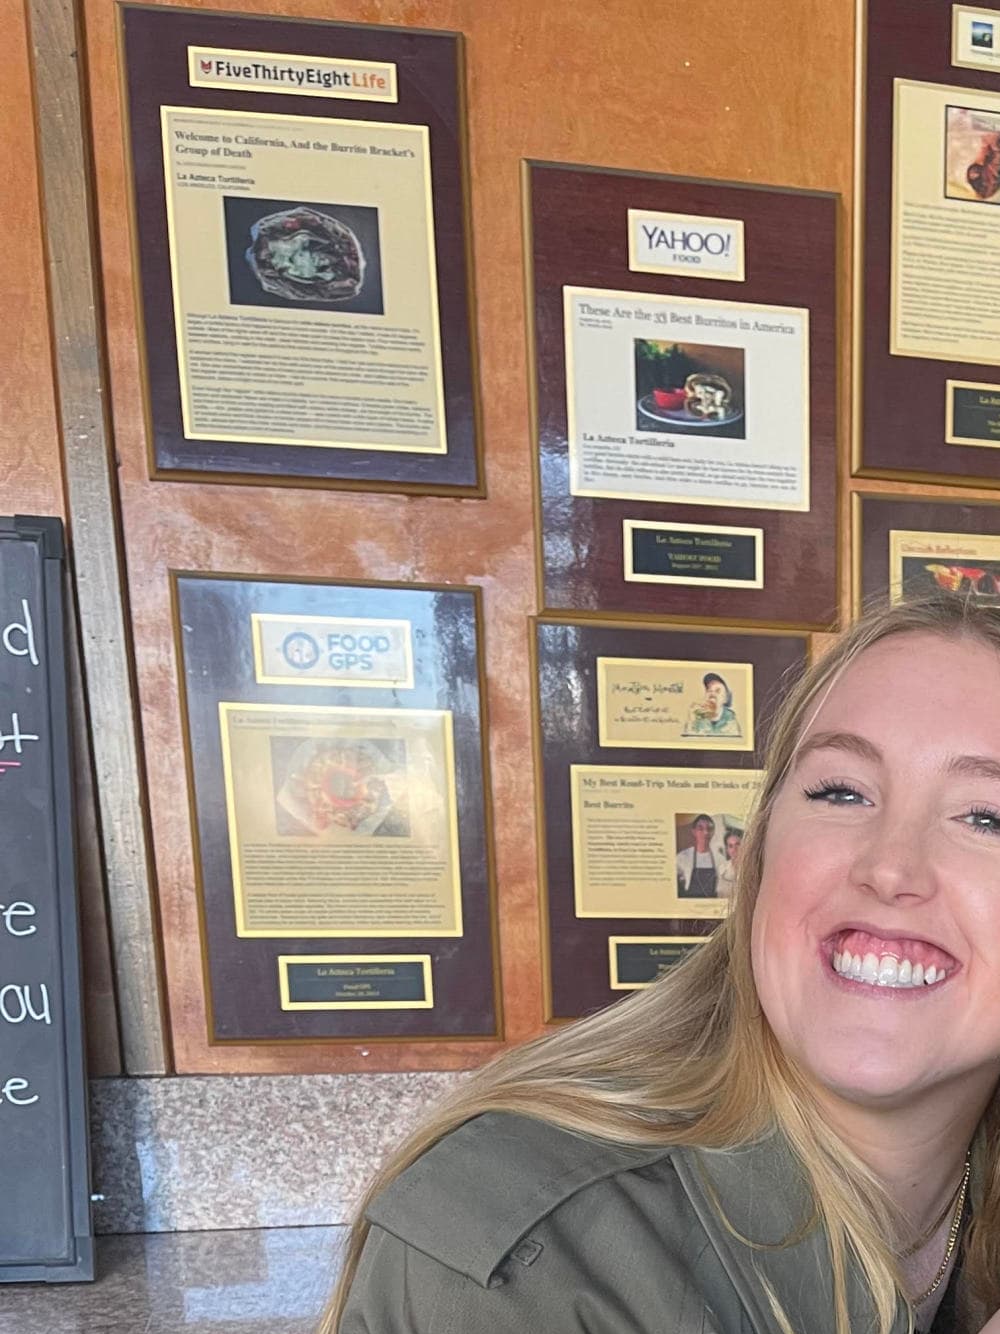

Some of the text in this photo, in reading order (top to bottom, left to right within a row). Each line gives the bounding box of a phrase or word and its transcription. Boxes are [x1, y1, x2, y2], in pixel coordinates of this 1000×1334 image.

[174, 131, 415, 158] Welcome to California, And the Burrito Bracket's
[175, 145, 252, 159] Group of Death
[642, 224, 731, 257] YAHOO!
[673, 253, 702, 263] FOOD
[578, 303, 611, 317] These
[613, 306, 632, 319] Are
[634, 308, 652, 321] the
[670, 312, 692, 325] Best
[695, 315, 737, 329] Burritos
[739, 318, 750, 330] in
[752, 320, 796, 335] America
[582, 432, 594, 442] La
[327, 633, 390, 653] FOOD
[328, 653, 374, 671] GPS
[583, 779, 597, 789] My
[600, 779, 618, 788] Best
[667, 780, 692, 789] Meals
[694, 780, 709, 789] and
[711, 780, 740, 790] Drinks
[742, 781, 751, 790] of
[584, 801, 602, 810] Best
